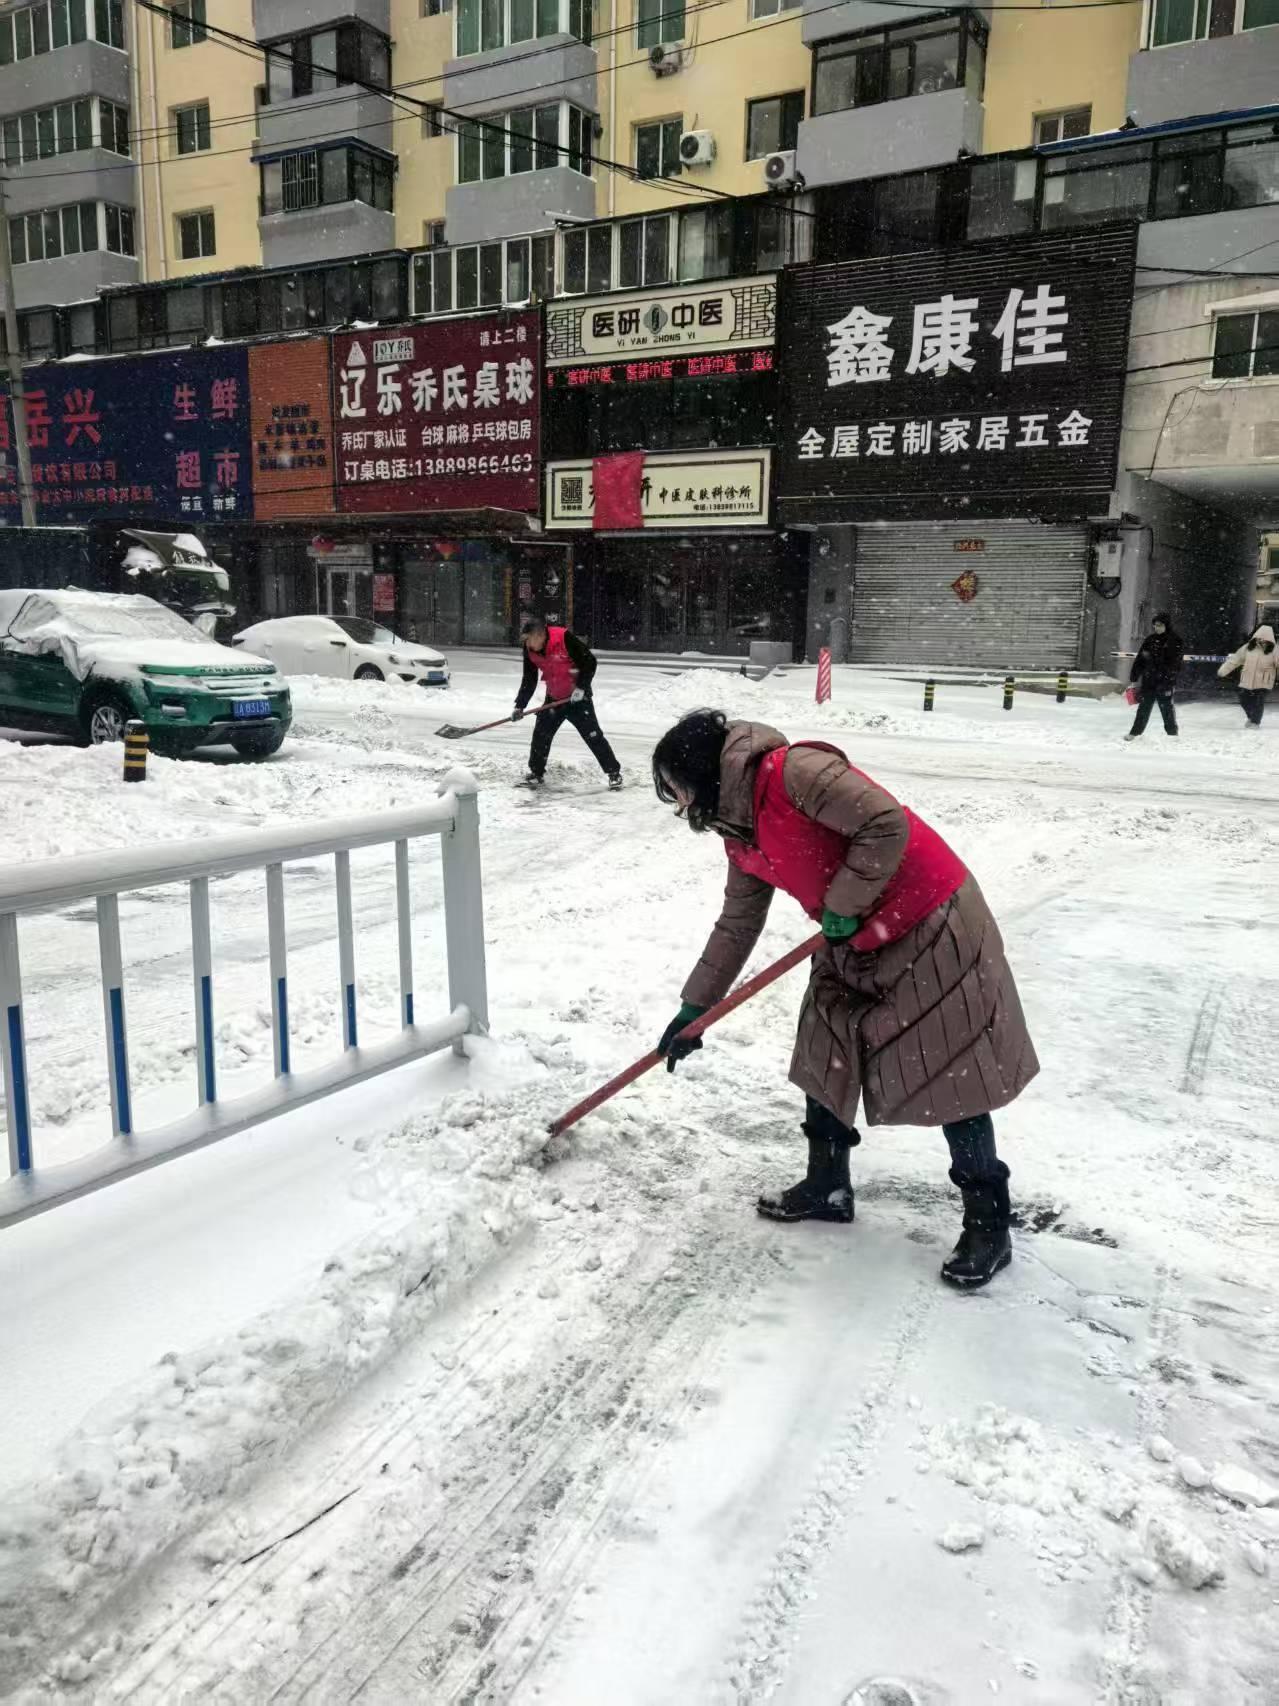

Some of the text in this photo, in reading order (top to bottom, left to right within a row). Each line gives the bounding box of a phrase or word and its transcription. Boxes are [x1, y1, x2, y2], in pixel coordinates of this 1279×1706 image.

[479, 326, 527, 347] 请上二楼
[592, 298, 723, 338] 医研 中医
[825, 284, 1069, 387] 鑫康佳
[174, 378, 238, 420] 生鲜
[339, 357, 535, 419] 辽乐乔氏桌球
[341, 428, 407, 450] 乔氏厂家认证
[421, 426, 444, 447] 台球
[446, 424, 469, 444] 麻将
[797, 409, 1093, 460] 全屋定制家居五金
[176, 449, 240, 488] 超市
[181, 495, 236, 512] 便宜 新鲜
[659, 484, 752, 504] 中医皮肤科诊所
